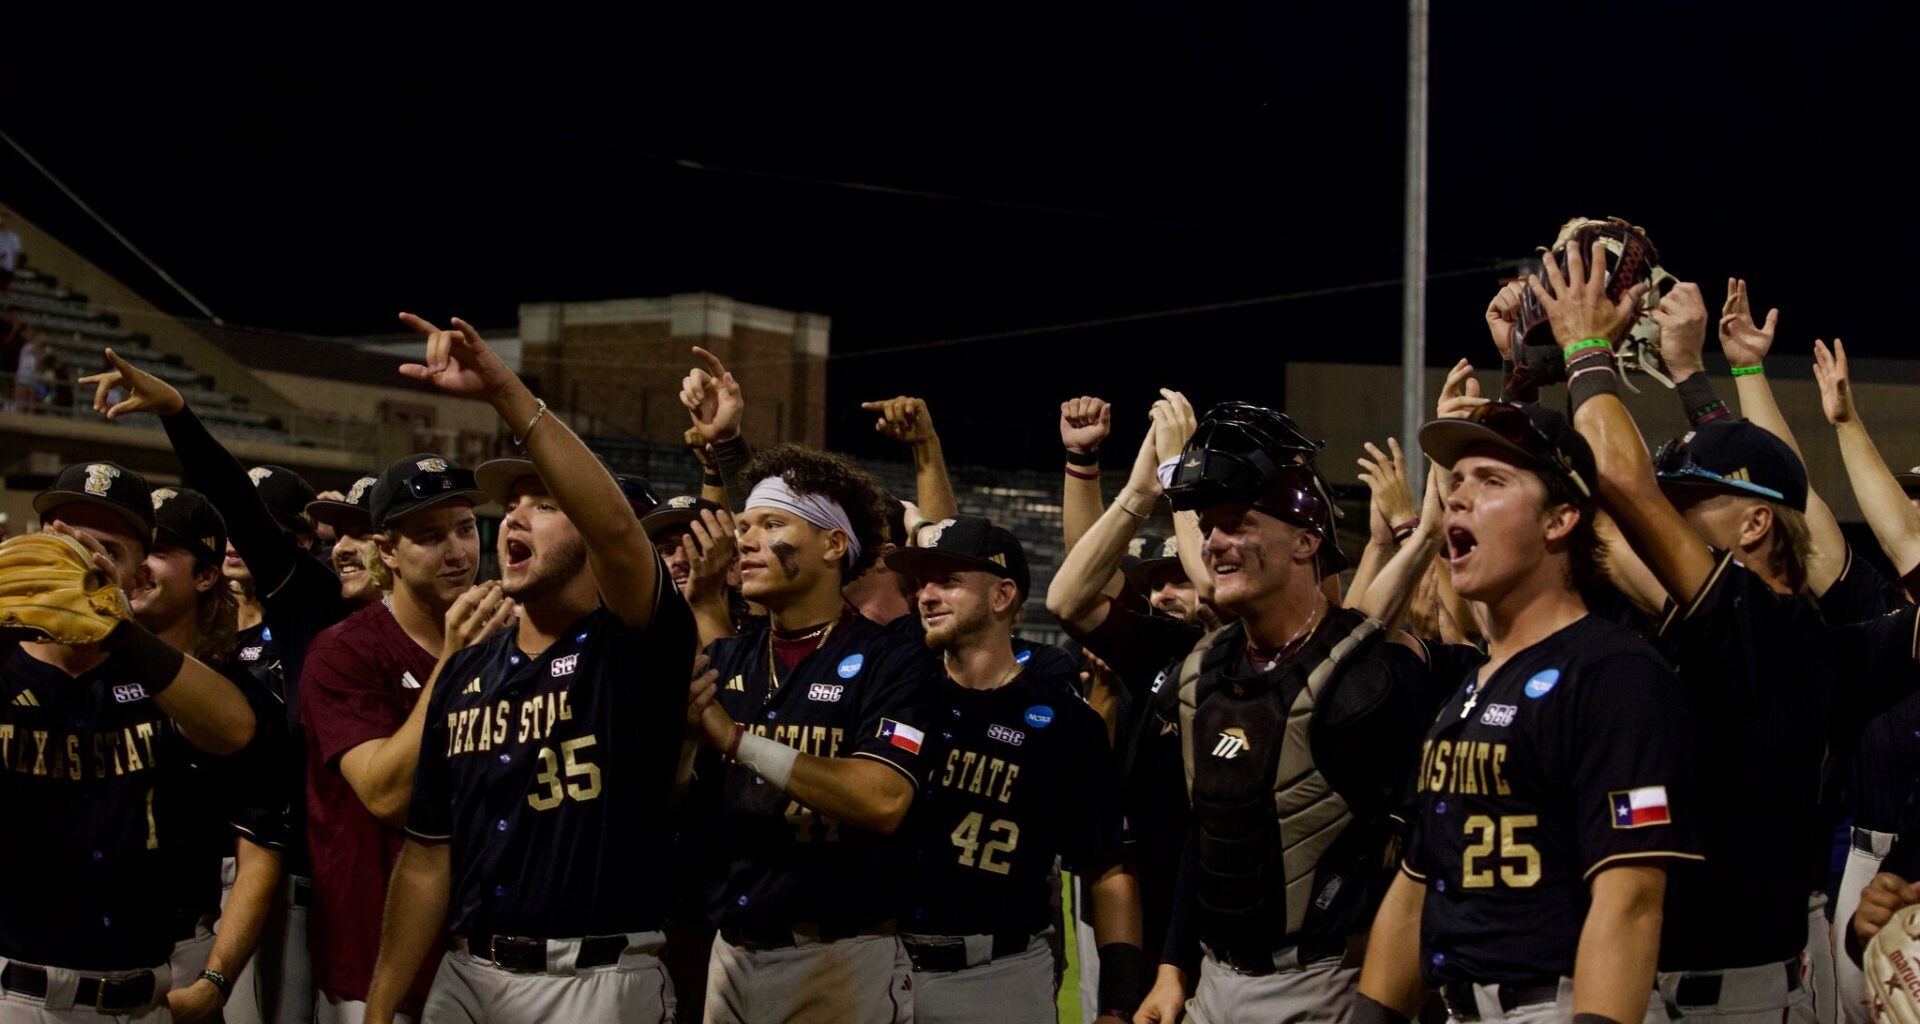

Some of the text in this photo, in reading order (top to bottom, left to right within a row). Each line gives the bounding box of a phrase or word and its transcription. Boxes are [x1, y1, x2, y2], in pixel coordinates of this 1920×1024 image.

[112, 683, 151, 703] SB
[551, 653, 580, 678] SB
[808, 683, 844, 702] SBC
[447, 700, 511, 758] TEXAS
[986, 723, 1026, 747] SBC
[1480, 703, 1518, 727] SBC
[0, 720, 163, 782] TEXAS STAT
[527, 734, 602, 811] 35
[942, 748, 1022, 805] STATE
[1449, 740, 1512, 796] STATE
[950, 810, 1020, 876] 42
[1462, 814, 1543, 889] 25
